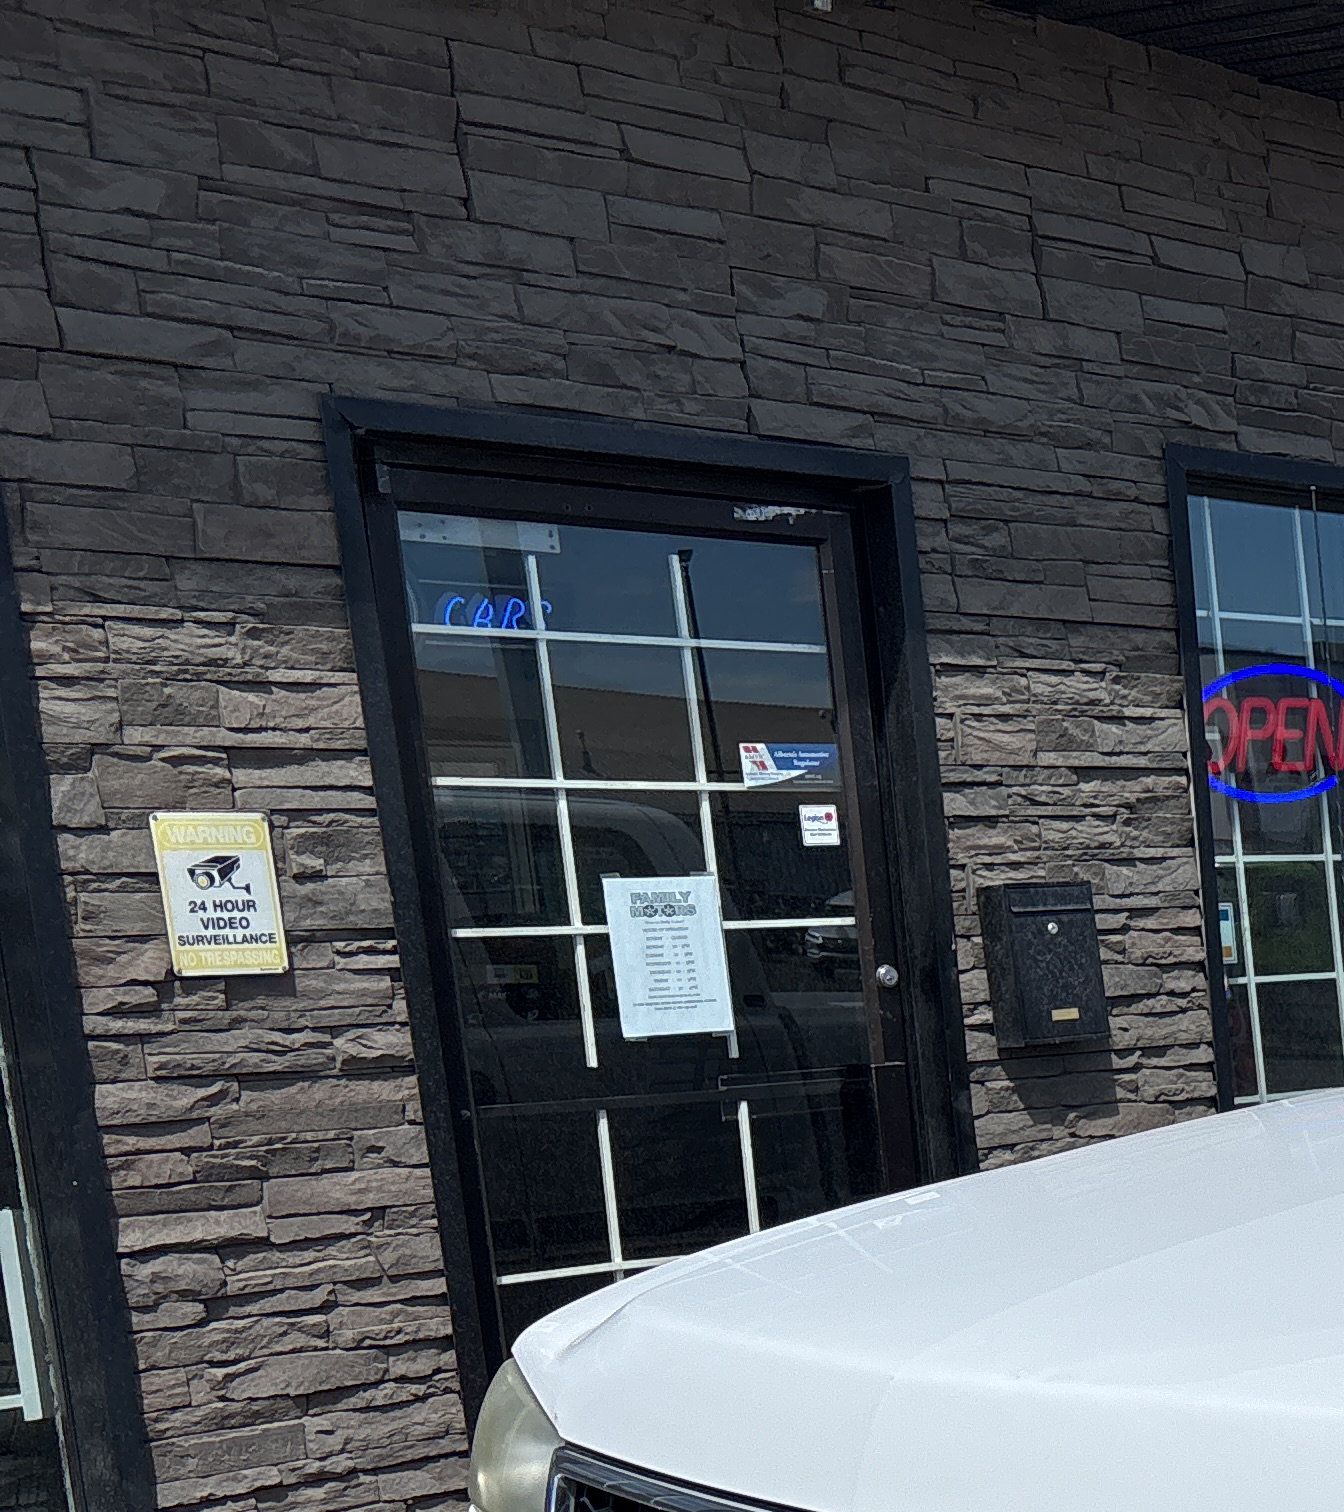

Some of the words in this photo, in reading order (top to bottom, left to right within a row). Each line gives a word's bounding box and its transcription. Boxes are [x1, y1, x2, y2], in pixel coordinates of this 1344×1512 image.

[165, 825, 257, 844] WARNING
[629, 890, 692, 905] FAMILY
[188, 900, 208, 914] 24
[212, 899, 258, 913] HOUR
[629, 903, 697, 918] MOTORS
[199, 916, 251, 931] VIDEO
[177, 932, 278, 947] SURVEILLANCE
[178, 952, 197, 968] NO
[200, 950, 282, 967] TRESPASSING
